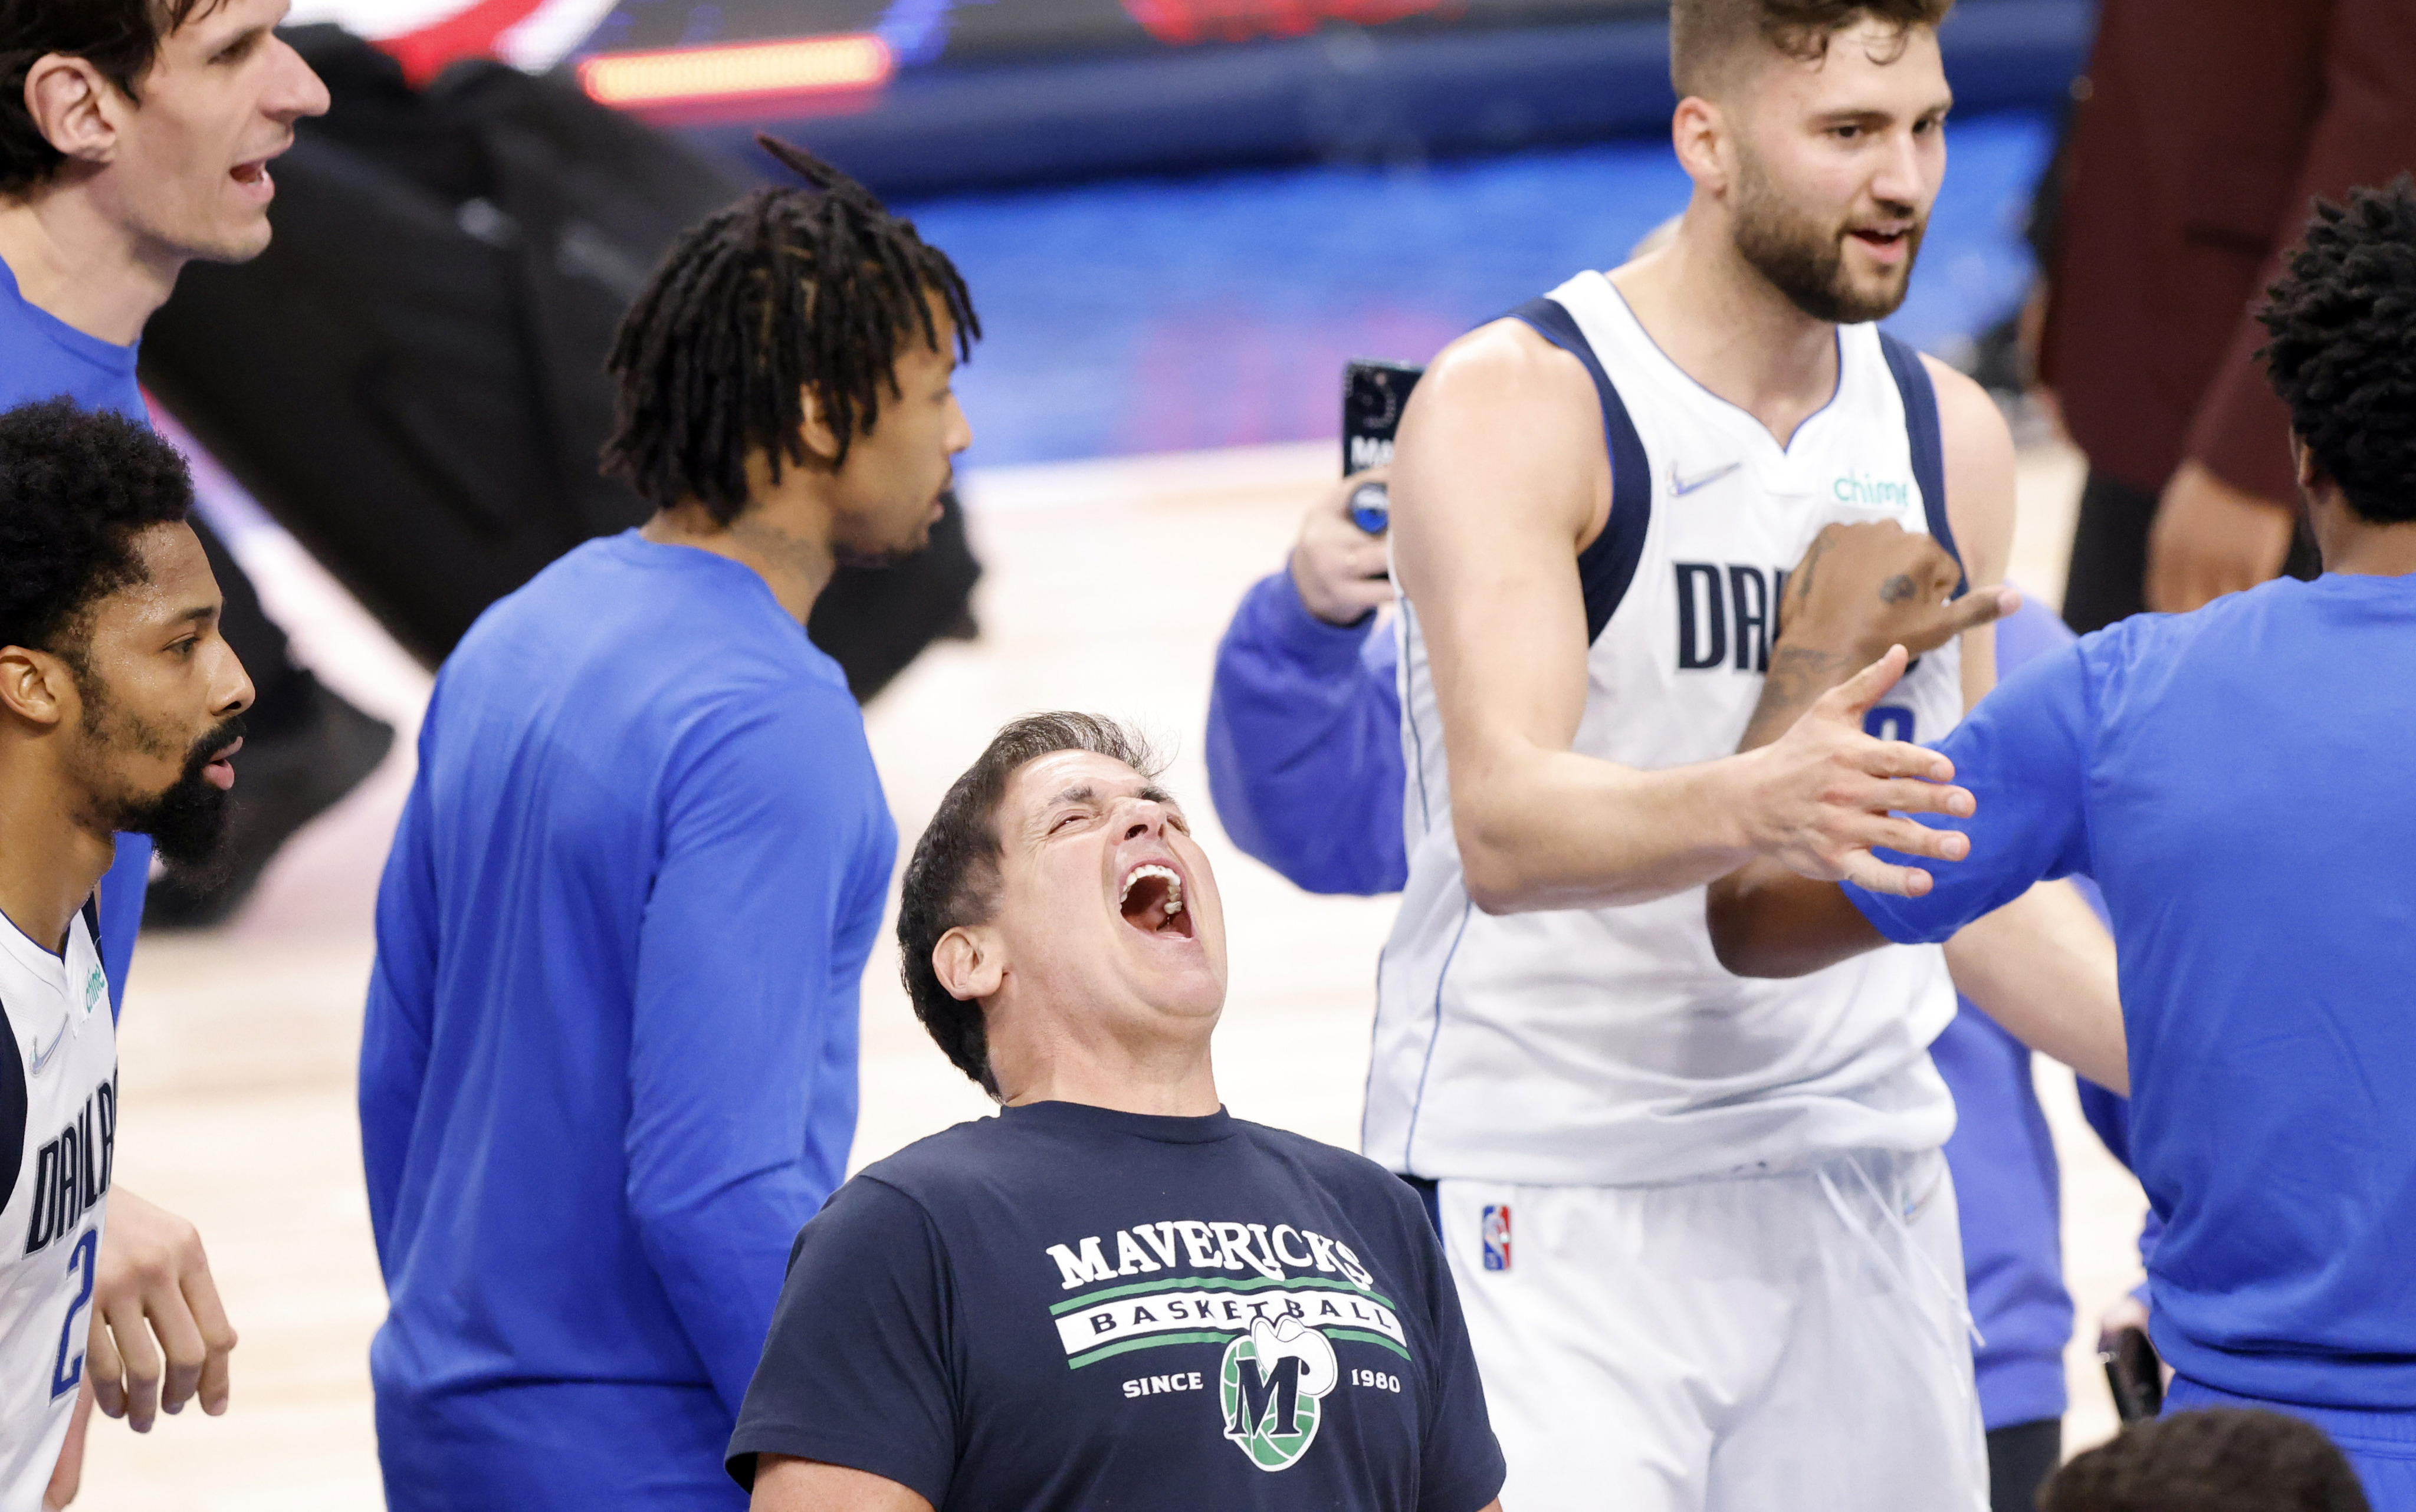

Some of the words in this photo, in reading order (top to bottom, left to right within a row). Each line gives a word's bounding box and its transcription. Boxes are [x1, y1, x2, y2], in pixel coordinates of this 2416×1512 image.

[23, 1066, 118, 1258] DALLA
[1046, 1221, 1374, 1291] MAVERICKS
[1090, 1299, 1393, 1333] BASKETBALL
[1123, 1372, 1204, 1398] SINCE
[1351, 1369, 1401, 1394] 1980
[1224, 1355, 1304, 1439] M
